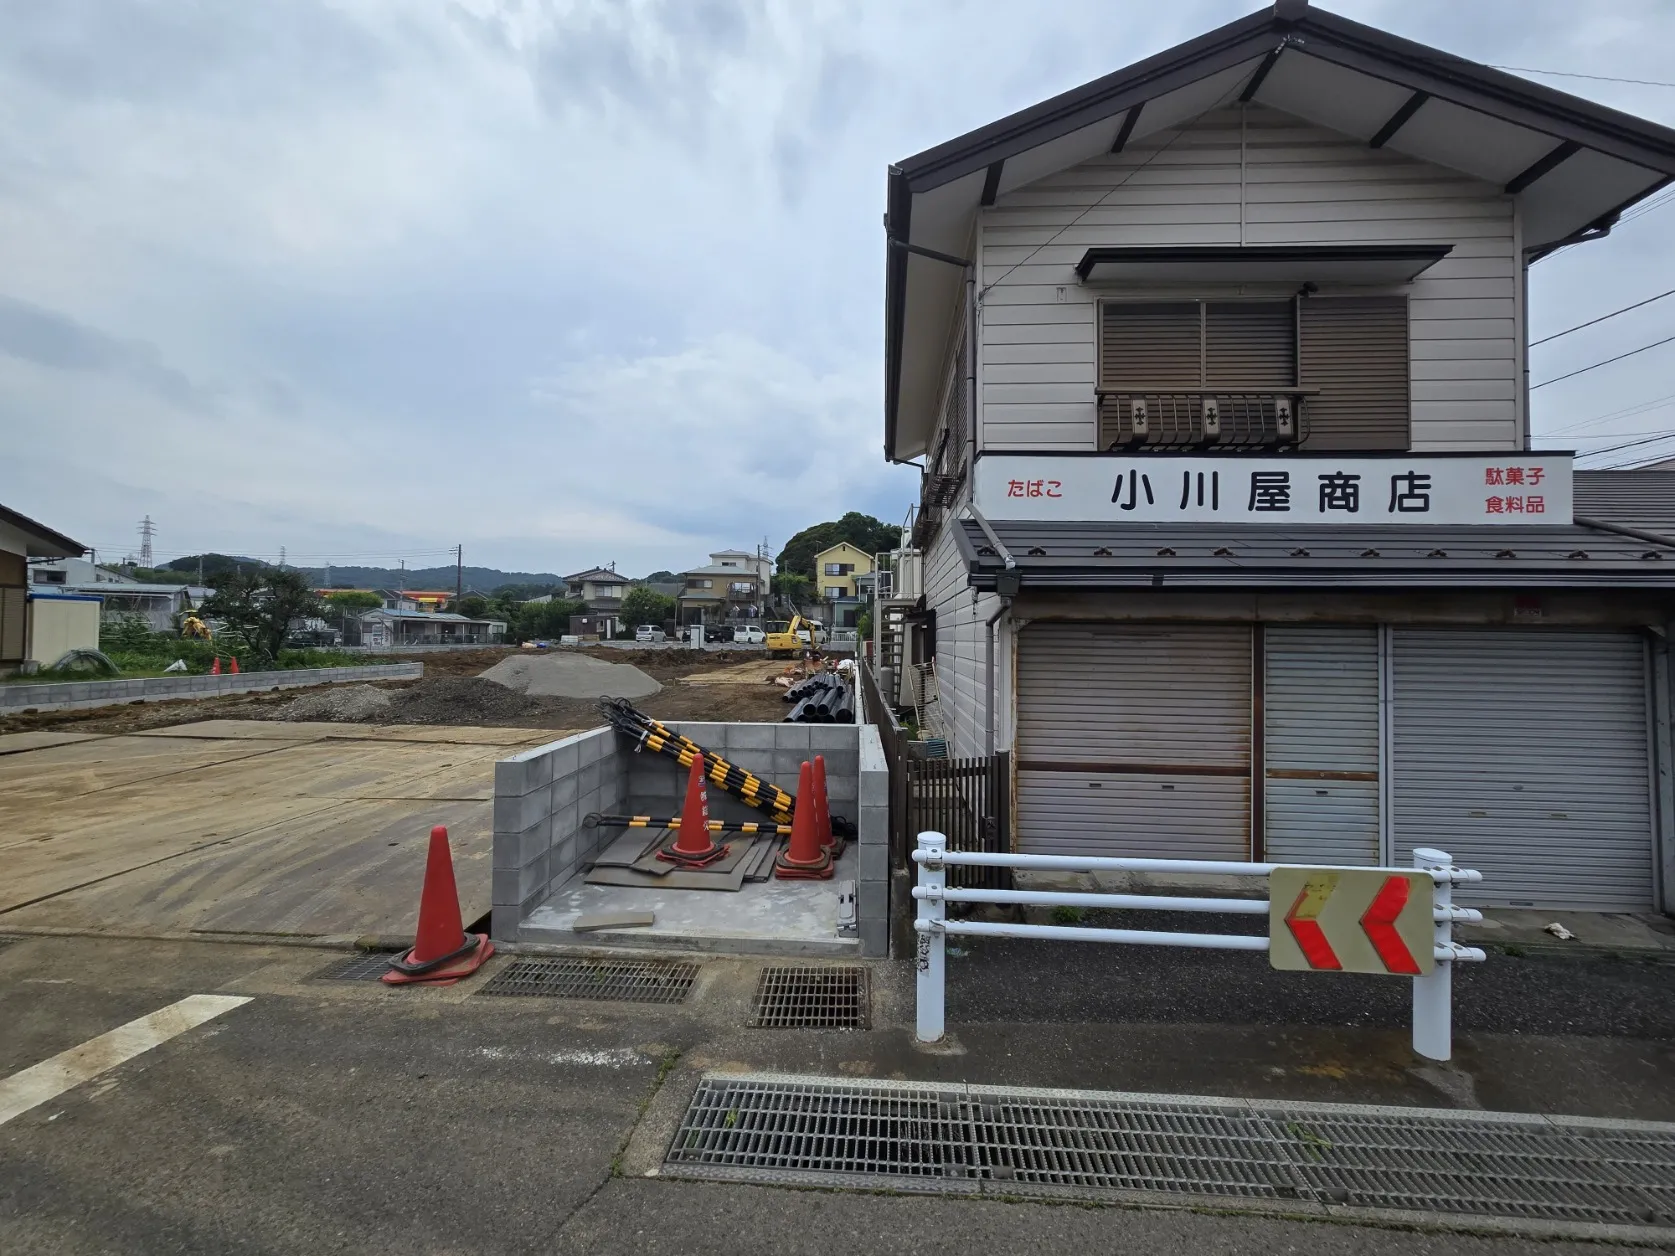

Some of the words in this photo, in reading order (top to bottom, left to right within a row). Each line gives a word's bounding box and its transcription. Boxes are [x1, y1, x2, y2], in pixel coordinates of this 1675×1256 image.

[1484, 466, 1545, 486] 駄菓子
[1007, 479, 1063, 498] たばこ
[1111, 469, 1431, 513] 小川屋商店
[1484, 496, 1545, 514] 食料品
